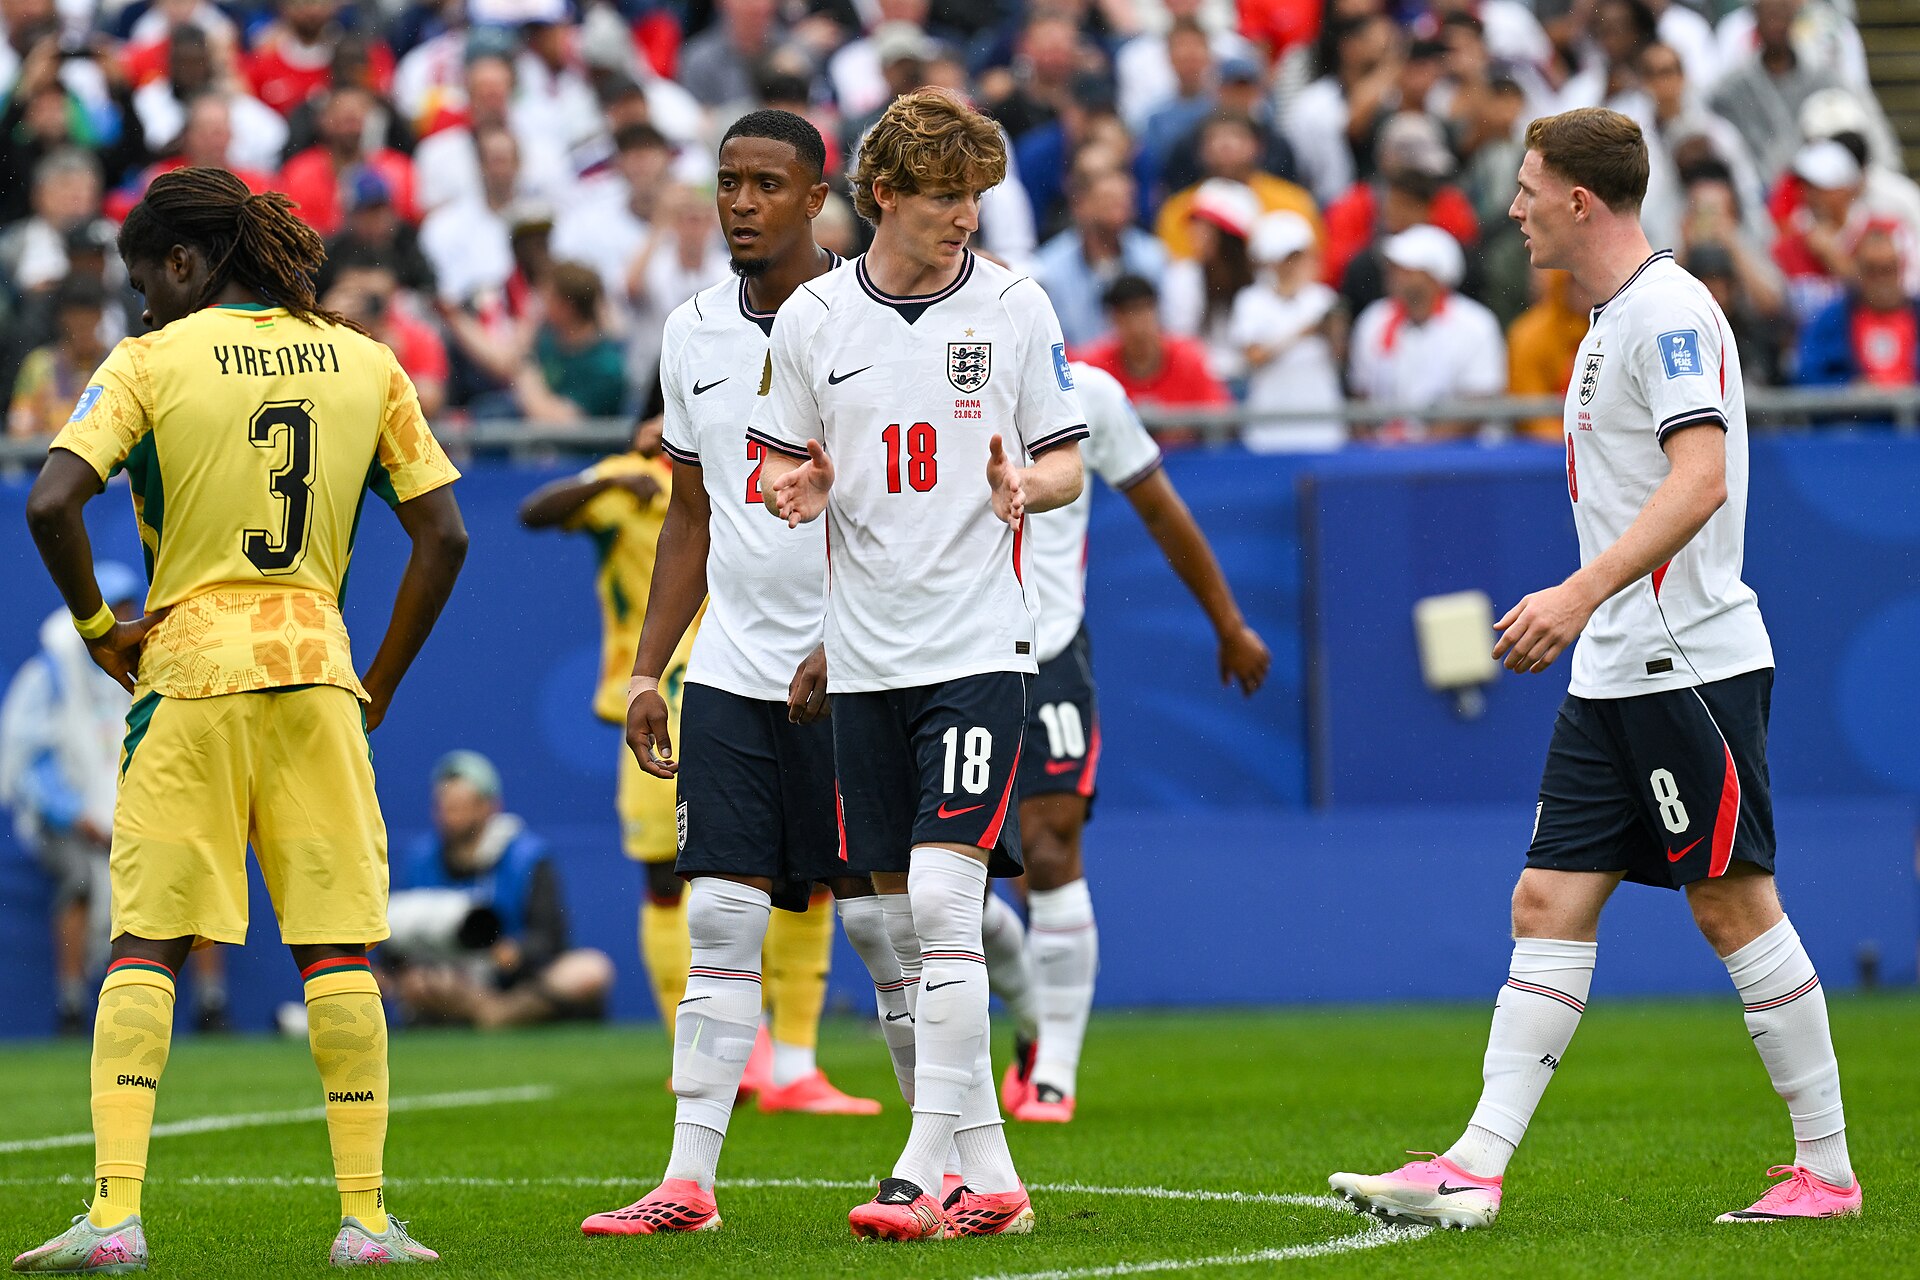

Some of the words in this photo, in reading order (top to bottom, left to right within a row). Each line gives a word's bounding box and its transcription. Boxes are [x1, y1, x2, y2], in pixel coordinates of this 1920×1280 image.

[213, 343, 340, 376] YIRENKYI
[954, 410, 982, 419] 23.06.26
[955, 399, 981, 408] GHANA
[881, 422, 938, 494] 18
[242, 399, 317, 576] 3
[1038, 701, 1086, 759] 10
[942, 726, 993, 795] 18
[1650, 768, 1690, 834] 8
[1539, 1053, 1559, 1072] EN
[117, 1074, 157, 1091] GHANA
[328, 1090, 375, 1102] GHANA
[100, 1177, 108, 1198] AND
